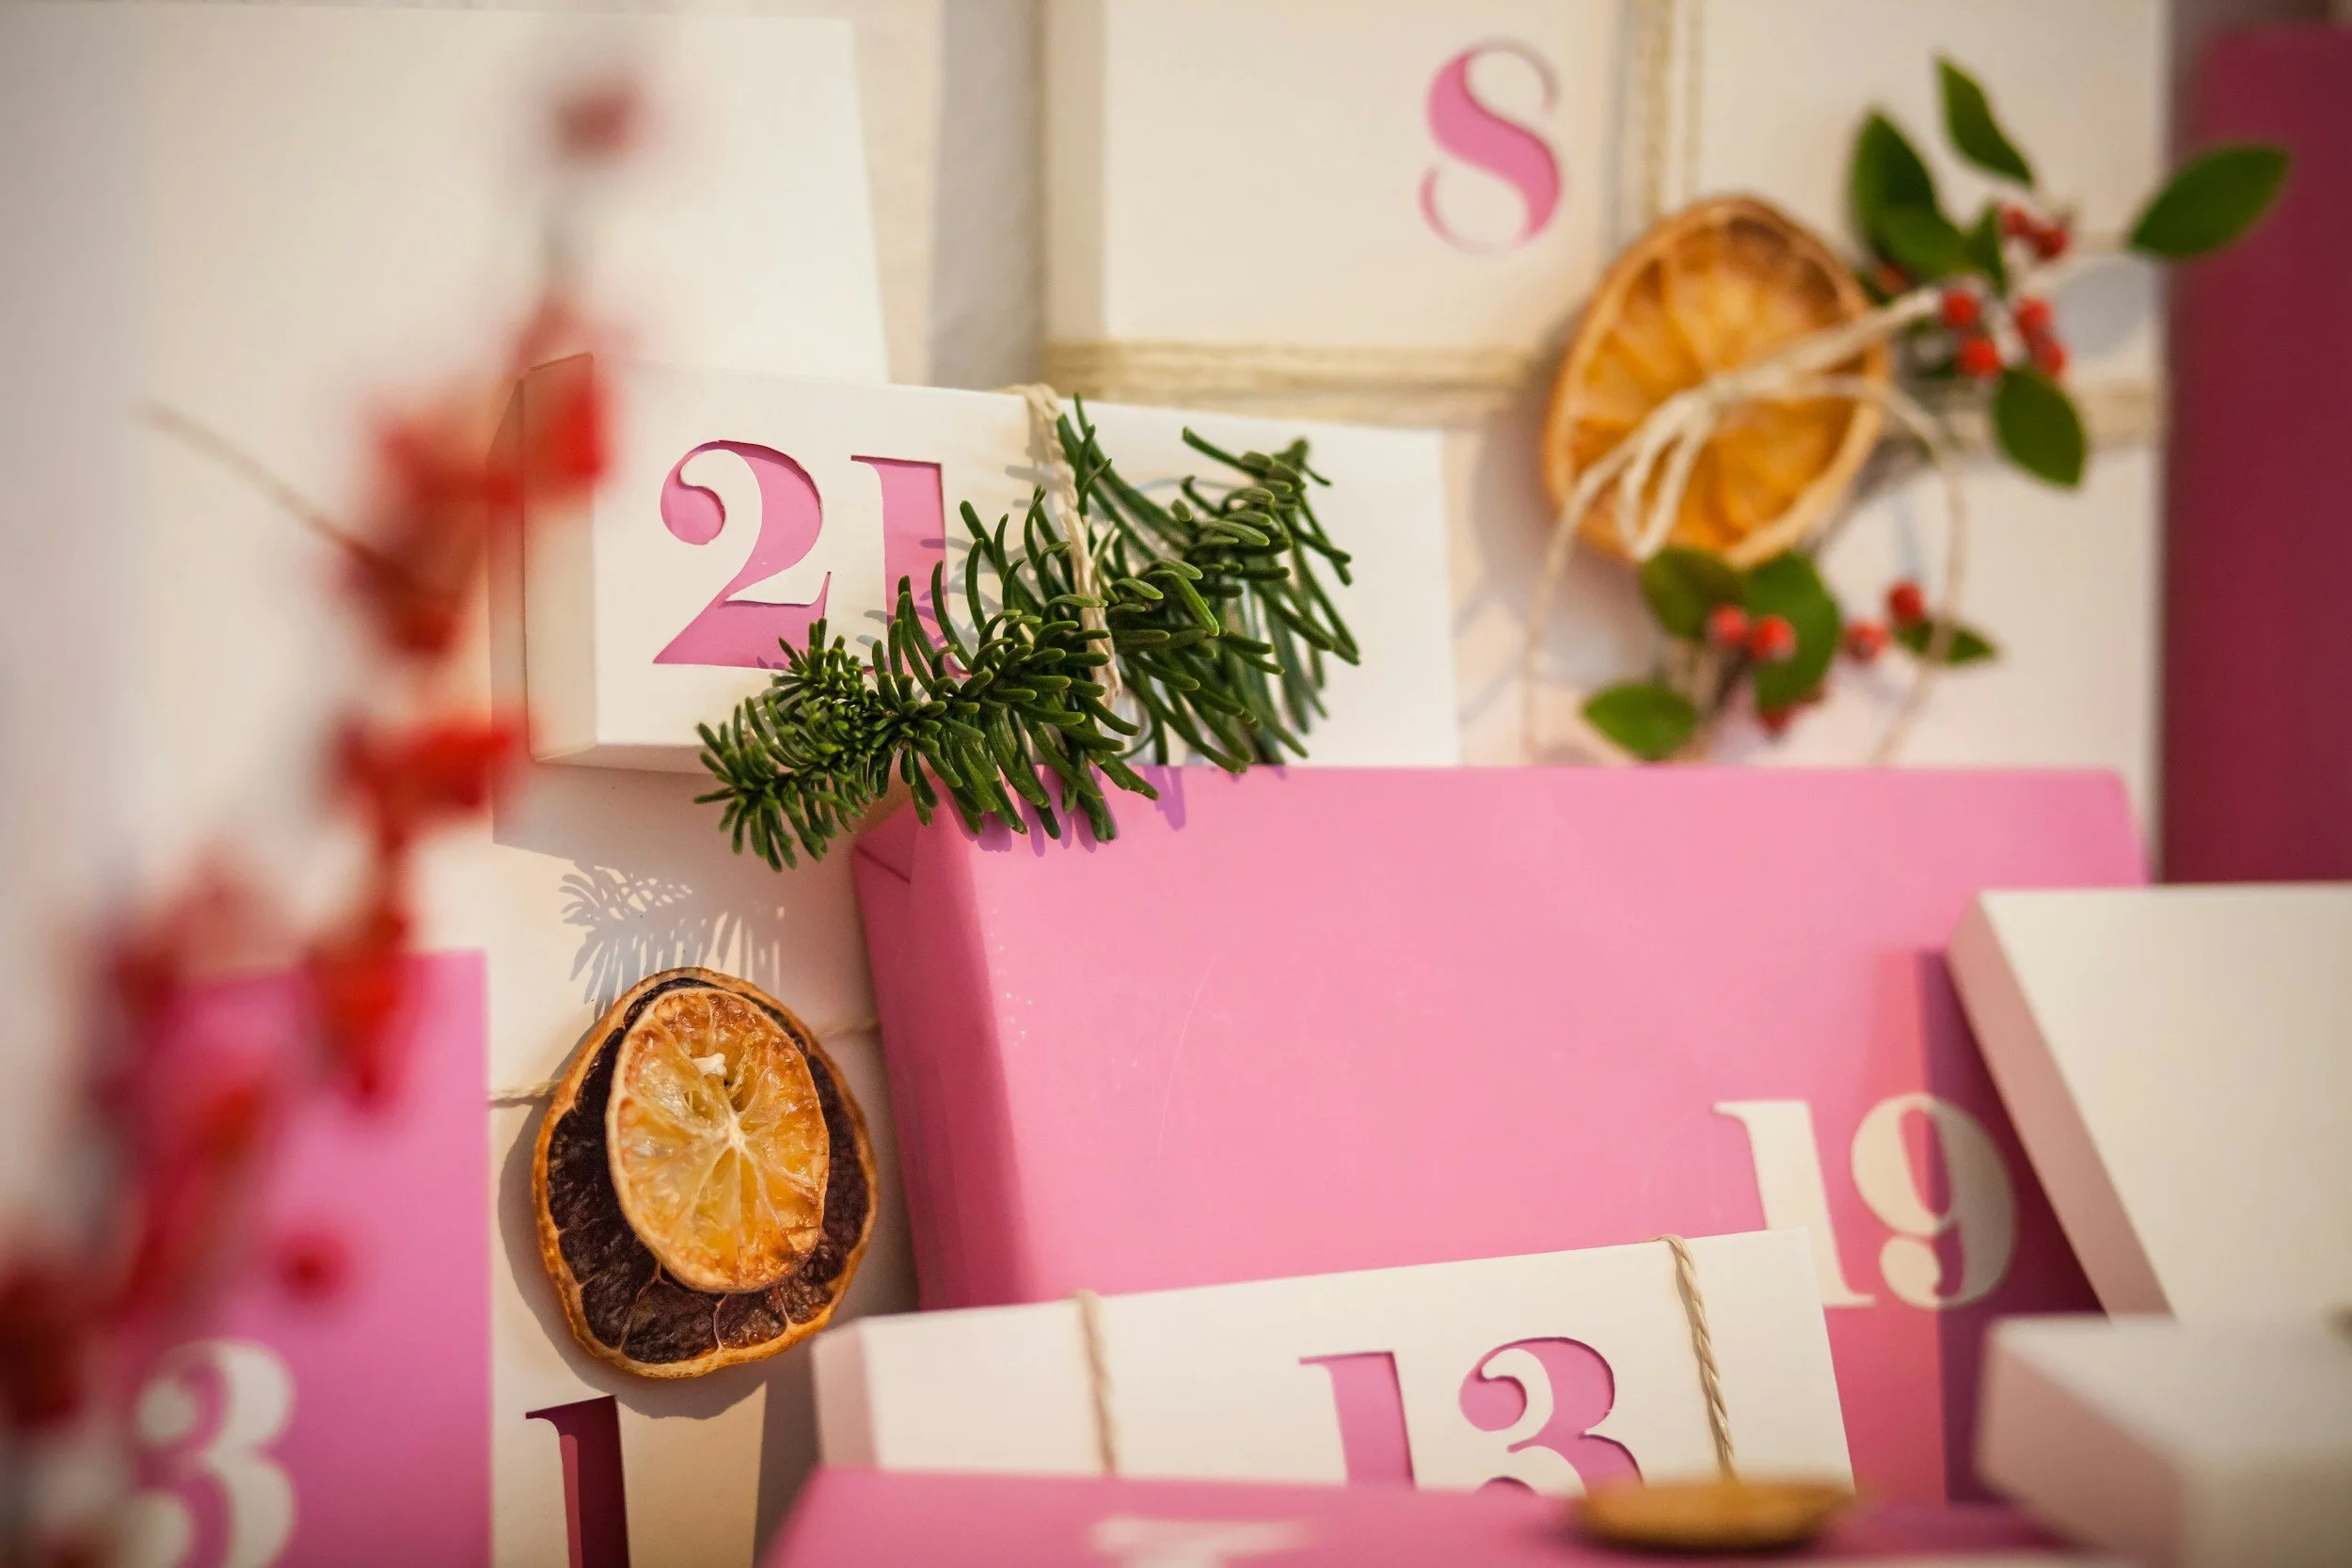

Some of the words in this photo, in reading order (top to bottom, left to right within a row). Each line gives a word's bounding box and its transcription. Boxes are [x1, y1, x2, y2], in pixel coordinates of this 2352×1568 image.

[1419, 38, 1562, 255] 8
[653, 439, 971, 679] 21
[1712, 1092, 2017, 1309] 19
[525, 1394, 630, 1568] 1
